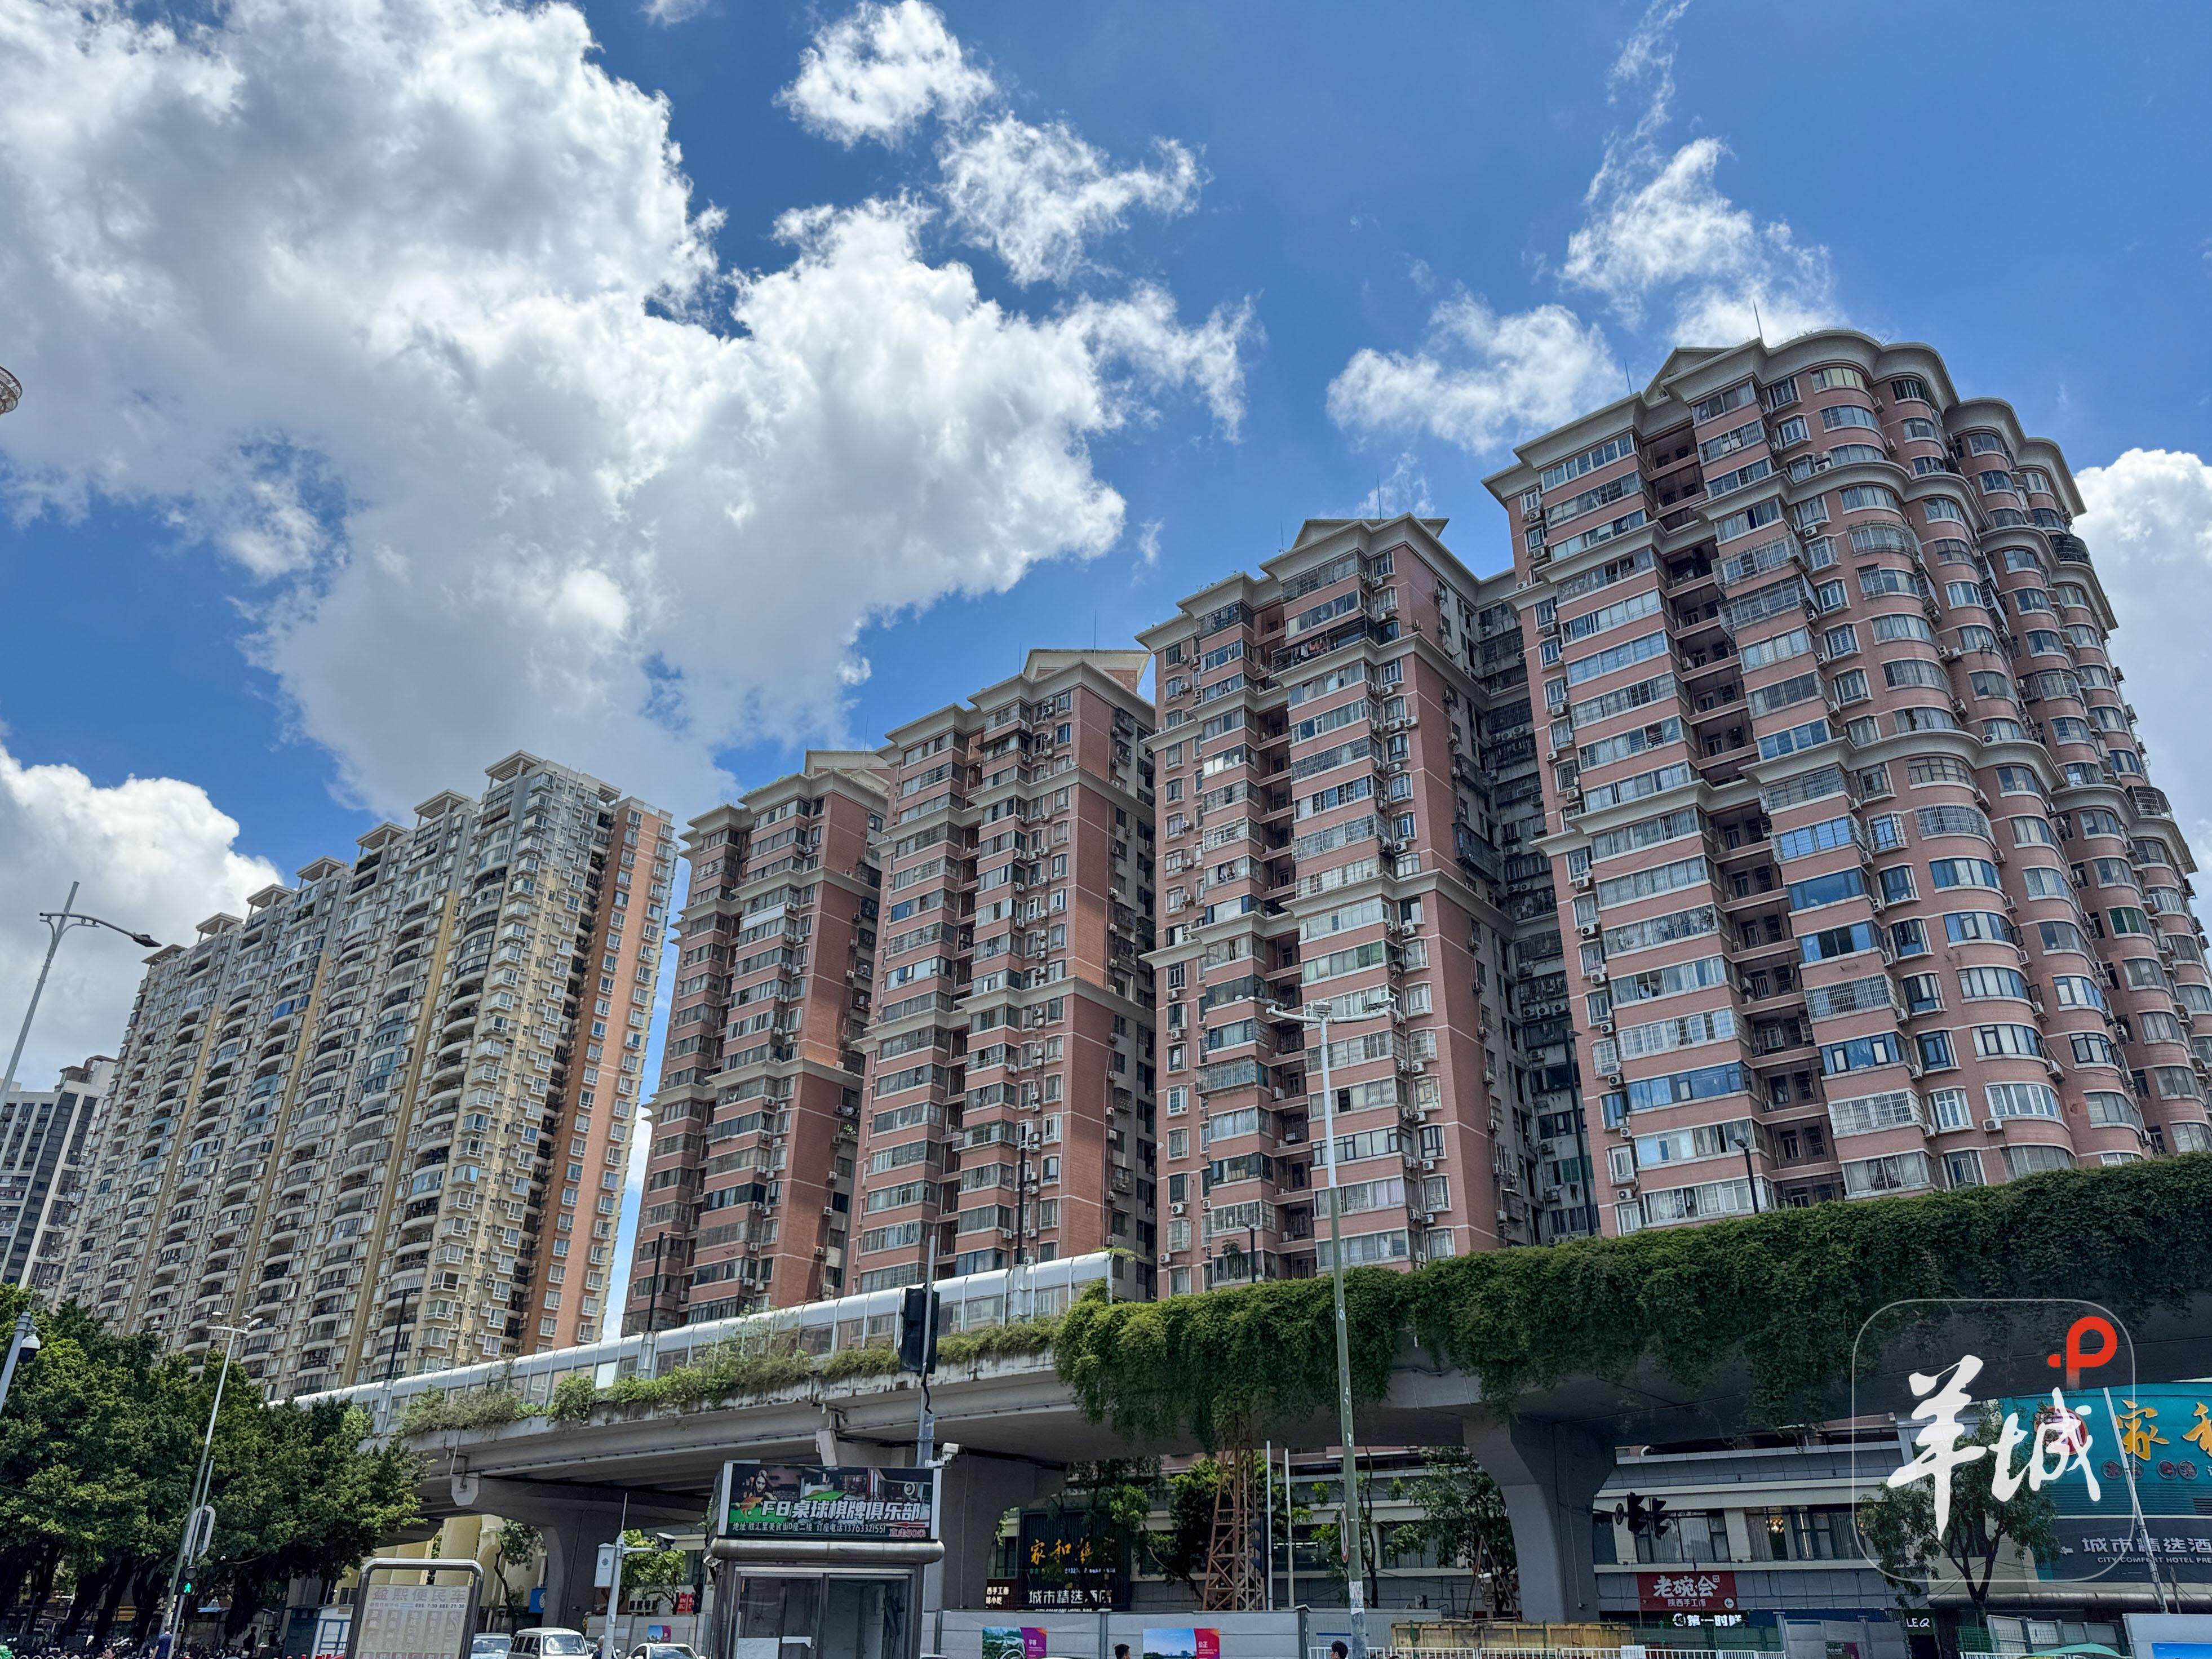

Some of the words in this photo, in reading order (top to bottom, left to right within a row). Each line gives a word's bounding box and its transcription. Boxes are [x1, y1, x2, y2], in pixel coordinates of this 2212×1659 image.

[761, 1500, 921, 1521] F8桌球棋牌俱乐部
[1653, 1575, 1719, 1597] 老碗会
